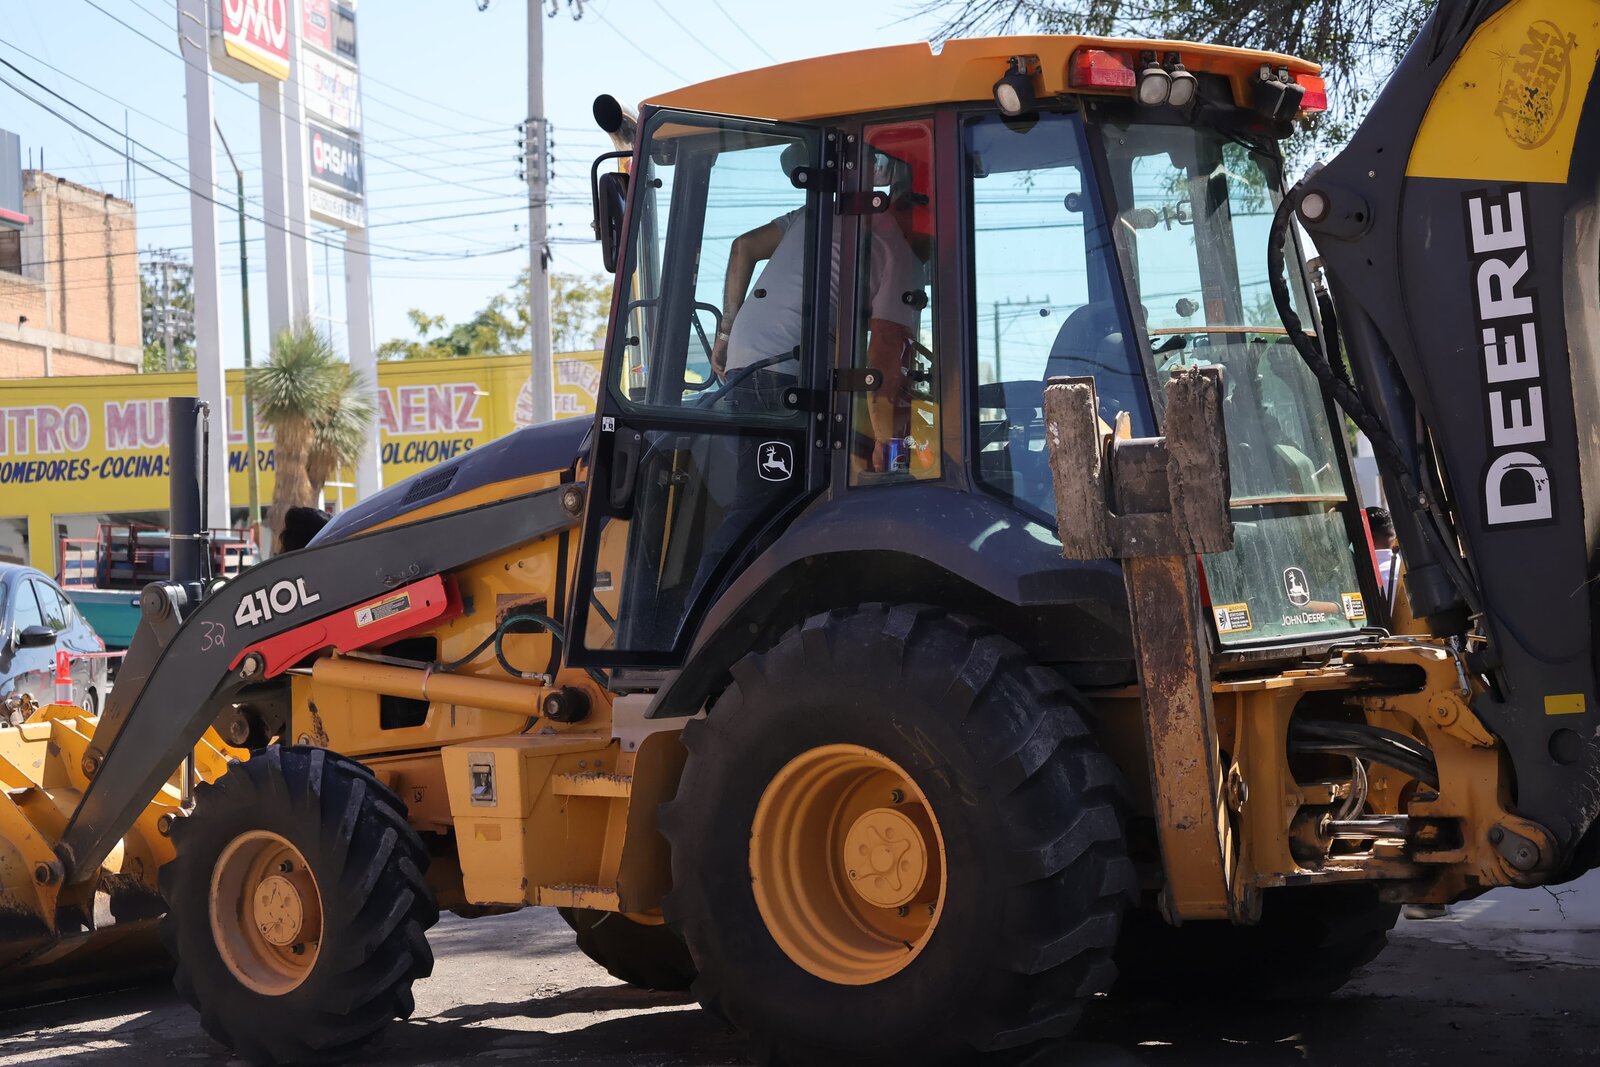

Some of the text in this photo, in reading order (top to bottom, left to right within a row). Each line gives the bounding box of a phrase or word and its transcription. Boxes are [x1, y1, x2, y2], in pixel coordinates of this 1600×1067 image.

[1494, 26, 1550, 118] TEAM
[313, 134, 359, 182] ORSAN
[1468, 191, 1553, 525] DEERE
[0, 405, 87, 451] TRO
[378, 384, 482, 435] AENZ
[0, 455, 170, 484] OMEDORES-COCINAS
[381, 438, 474, 465] OLCHONES
[234, 577, 321, 627] 410L
[1281, 612, 1326, 627] JOHN DEERE
[200, 621, 226, 651] 32
